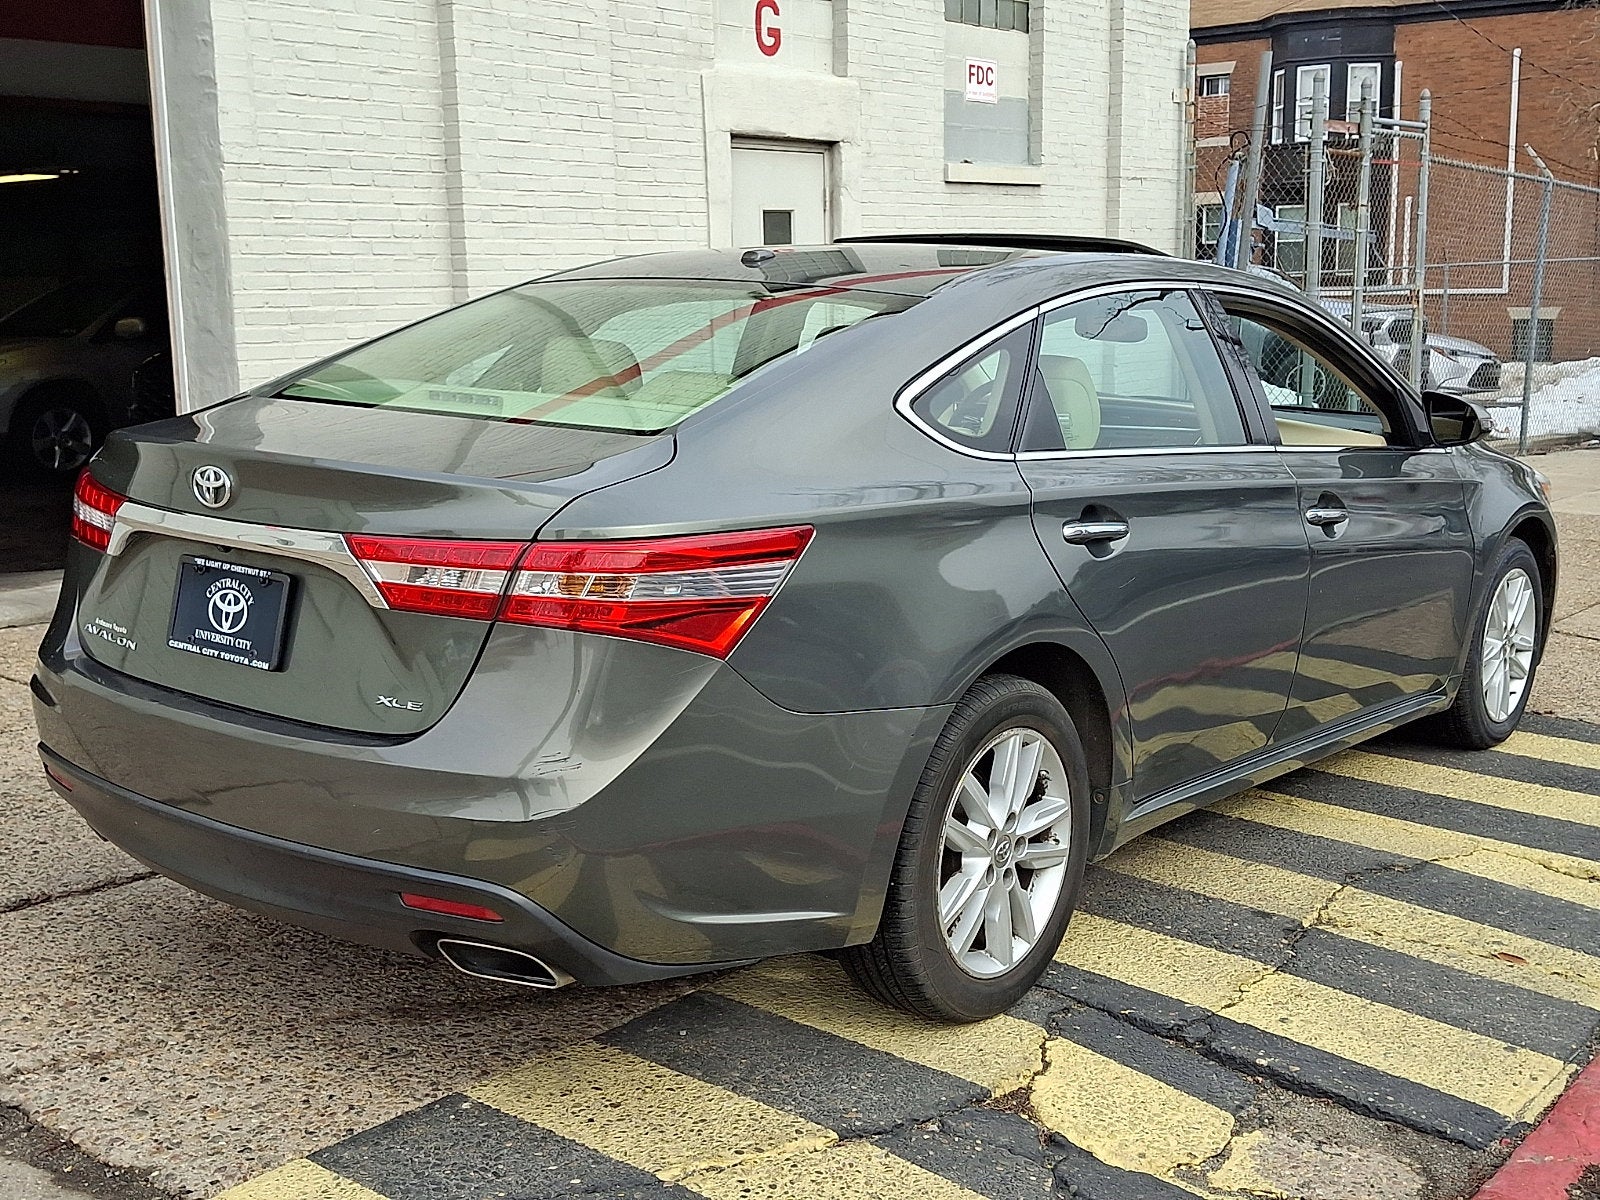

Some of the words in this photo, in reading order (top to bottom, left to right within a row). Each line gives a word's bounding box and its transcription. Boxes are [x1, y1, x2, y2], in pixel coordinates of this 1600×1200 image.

[755, 0, 781, 57] G
[968, 64, 994, 86] FDC
[206, 560, 222, 569] LIGHT
[222, 563, 231, 571] UP
[231, 565, 259, 576] CHESTNUT
[206, 578, 240, 598] CENTRAL
[240, 584, 255, 606] CITY
[84, 623, 137, 651] AVALON
[195, 629, 235, 647] UNIVERSITY
[235, 638, 252, 651] CITY
[168, 640, 201, 653] CENTRAL
[201, 648, 219, 658] CITY
[219, 652, 249, 666] TOYOTA
[375, 695, 424, 711] XLE
